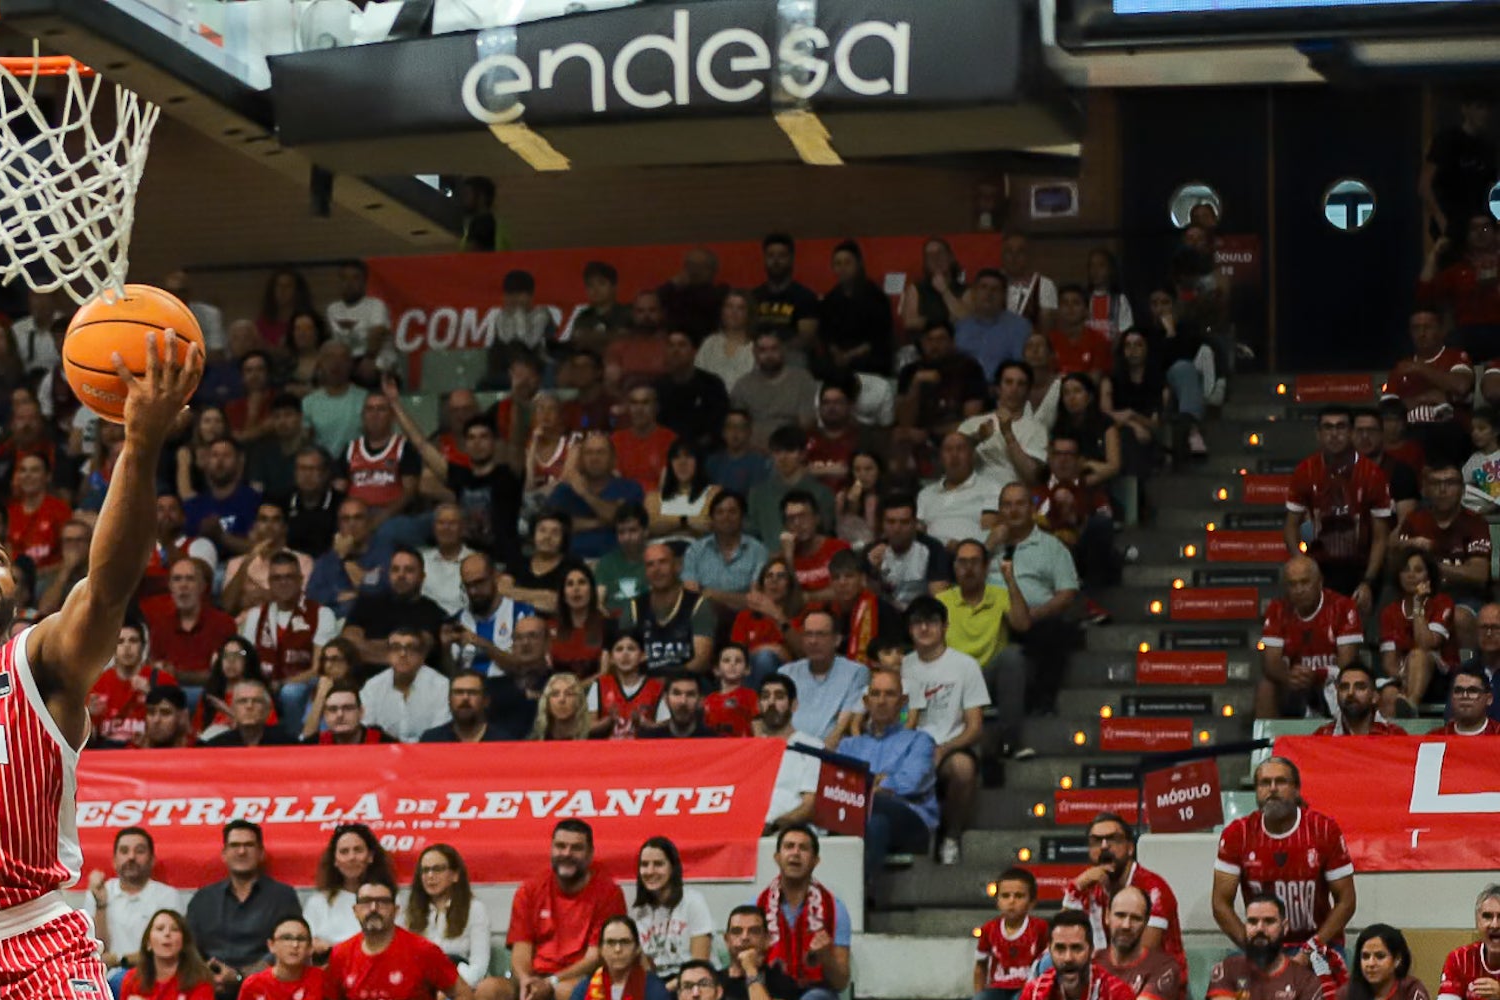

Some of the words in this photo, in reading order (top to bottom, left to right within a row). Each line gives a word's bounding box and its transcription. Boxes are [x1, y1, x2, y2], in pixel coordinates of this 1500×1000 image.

[462, 9, 910, 124] endesa
[76, 792, 383, 828] ESTRELLA
[395, 798, 438, 814] DE
[439, 785, 735, 821] LEVANTE
[1155, 783, 1211, 808] MÓDULO
